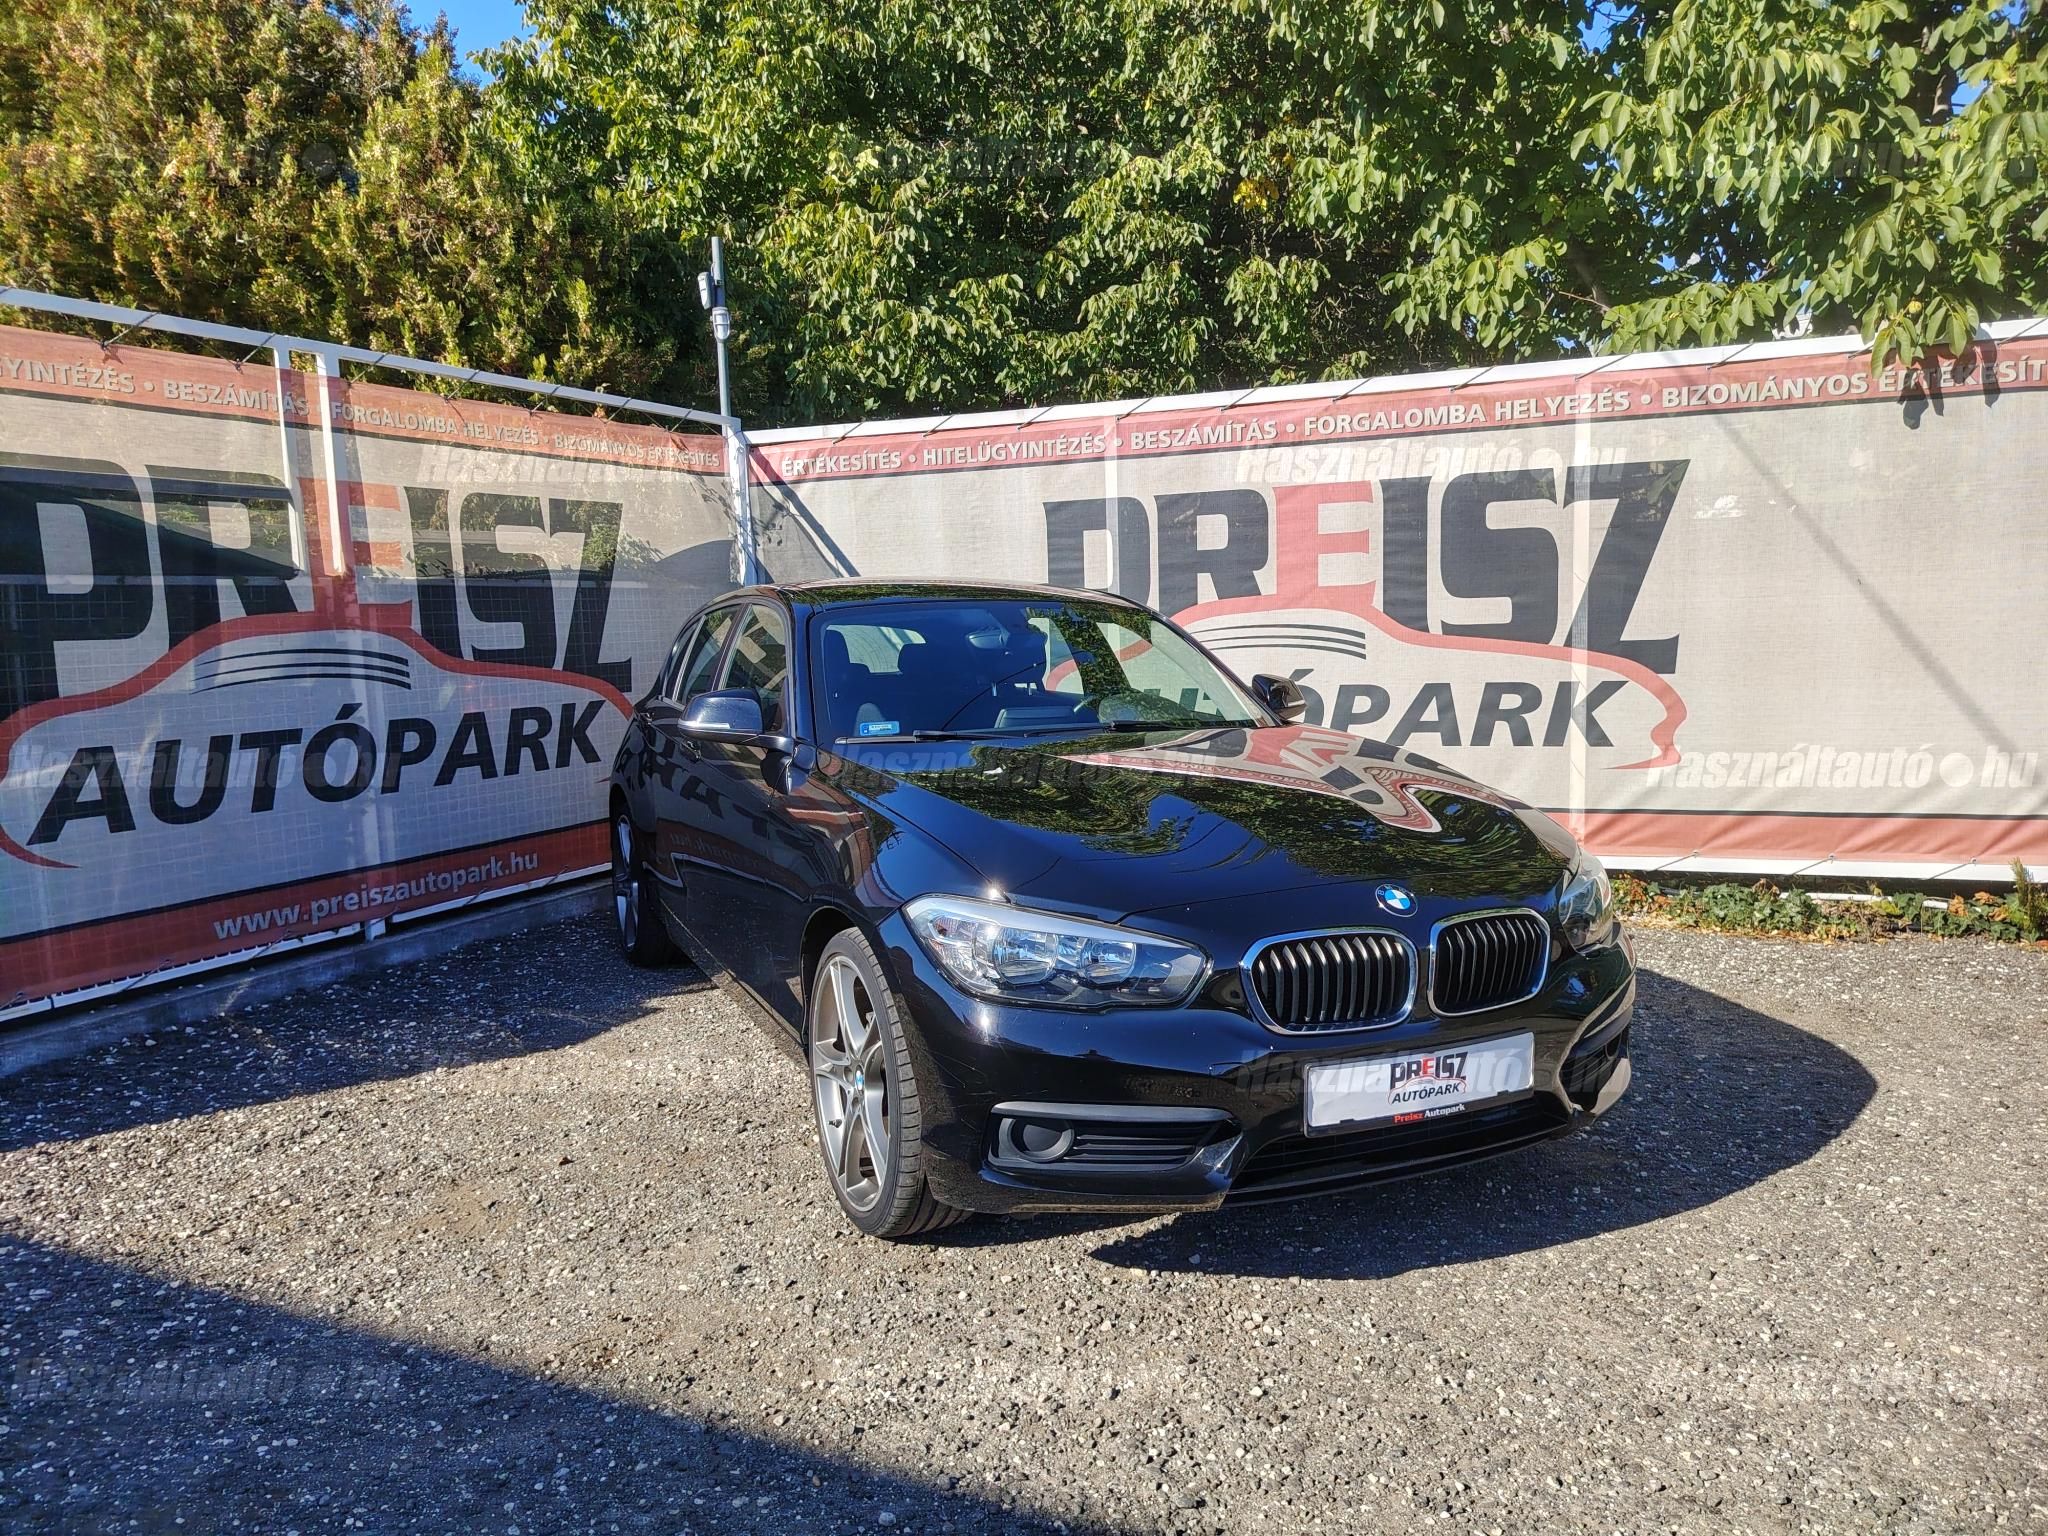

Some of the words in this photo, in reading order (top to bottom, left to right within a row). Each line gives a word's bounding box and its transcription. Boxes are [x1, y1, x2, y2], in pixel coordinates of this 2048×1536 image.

[0, 356, 135, 394] YINTÉZÉS
[163, 377, 310, 417] BESZÁMÍTÁS
[331, 401, 459, 435] FORGALOMBA
[463, 421, 540, 446] HELYEZÉS
[781, 450, 902, 477] ÉRTÉKESÍTÉS
[922, 433, 1105, 466] HITELÜGYINTÉZÉS
[1130, 415, 1277, 450] BESZÁMÍTÁS
[1304, 403, 1486, 437] FORGALOMBA
[1495, 387, 1631, 421] HELYEZÉS
[1662, 371, 1868, 408] BIZOMÁNYOS
[0, 451, 632, 715] PREISZ
[27, 700, 606, 845] AUTÓPARK
[213, 851, 539, 940] www.preiszautopark.hu
[1390, 1051, 1468, 1090] PREISZ
[1391, 1082, 1461, 1104] AUTÓPARK
[1394, 1112, 1424, 1123] Preisz
[1424, 1103, 1465, 1119] Autopark
